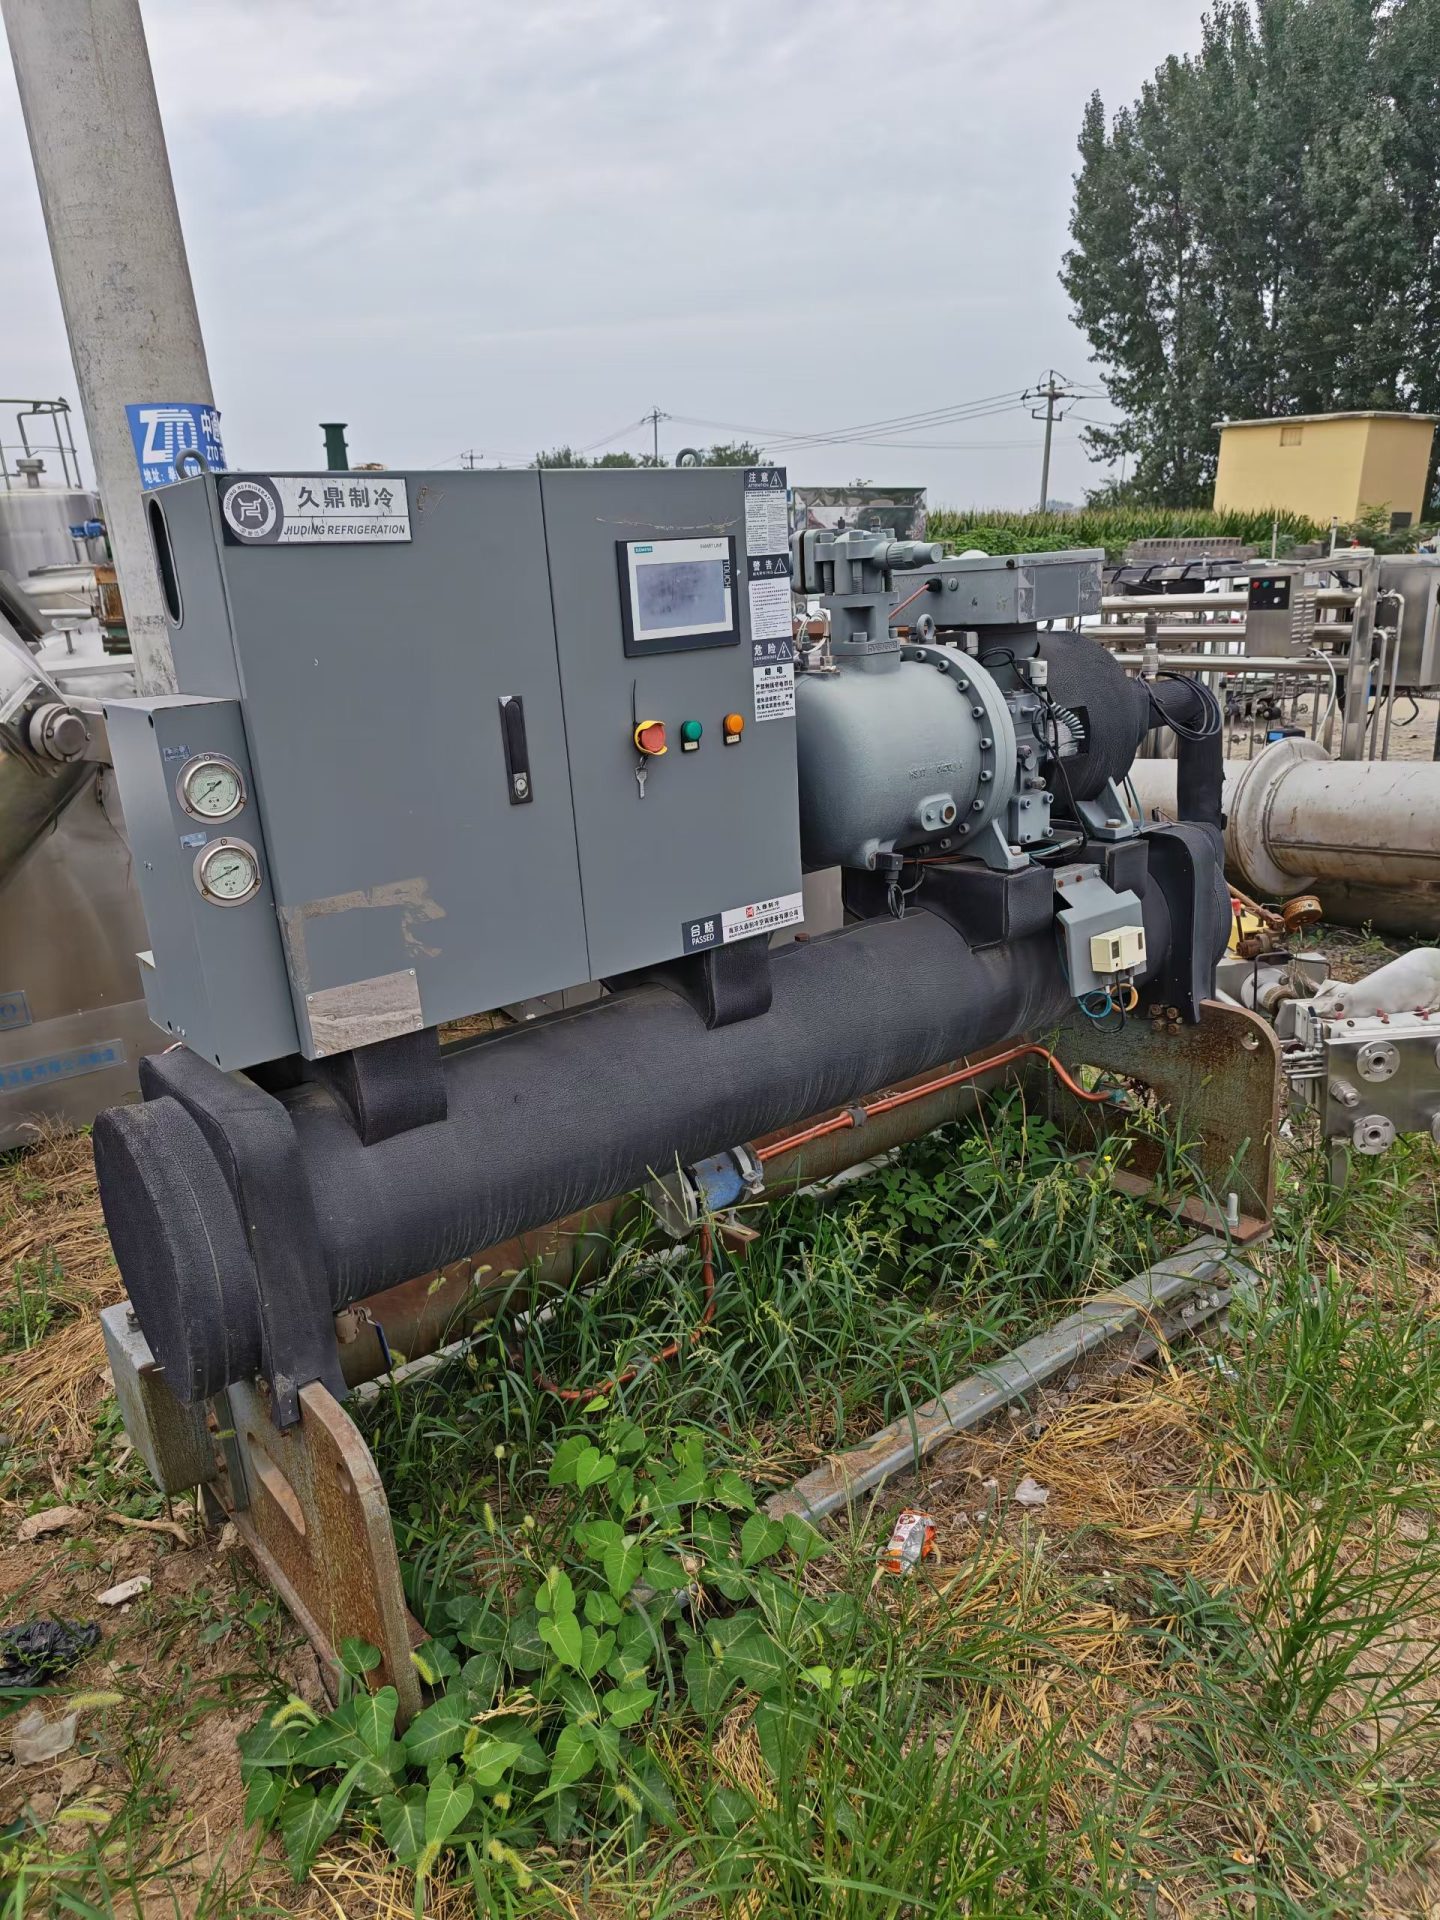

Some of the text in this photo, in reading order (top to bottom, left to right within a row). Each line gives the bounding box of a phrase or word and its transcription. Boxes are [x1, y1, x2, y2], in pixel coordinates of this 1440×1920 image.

[140, 409, 198, 464] ZTO
[206, 445, 219, 461] ZTO
[748, 471, 769, 483] 注意
[298, 486, 394, 509] 久鼎制冷
[284, 524, 406, 536] JIUDING REFRIGERATION
[752, 560, 773, 571] 警告
[723, 560, 732, 589] TOUCH
[754, 643, 777, 656] 危险
[690, 920, 714, 938] 合格
[691, 933, 715, 946] PASSED
